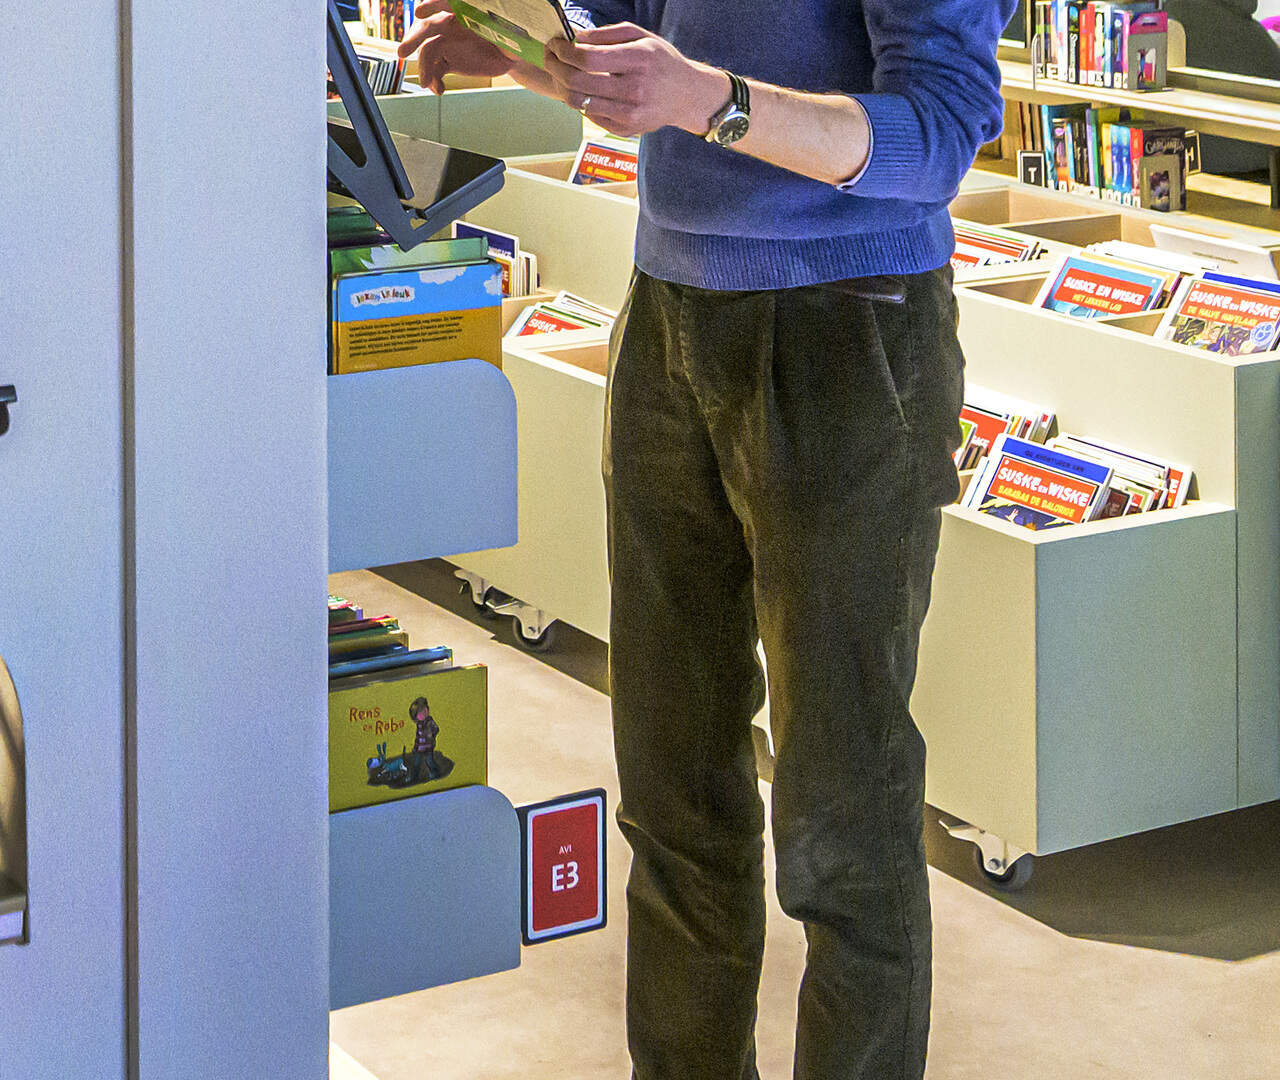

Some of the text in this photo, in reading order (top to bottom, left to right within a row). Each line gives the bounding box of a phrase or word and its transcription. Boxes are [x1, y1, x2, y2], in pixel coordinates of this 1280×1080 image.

[1028, 167, 1038, 183] T
[1063, 276, 1144, 305] SUSKE EN WISKE
[1189, 290, 1233, 310] SUSKE
[998, 467, 1042, 491] SUSKE
[1048, 482, 1090, 507] WISKE
[349, 706, 381, 722] Rens
[558, 845, 573, 855] AVI
[552, 860, 580, 893] E3
